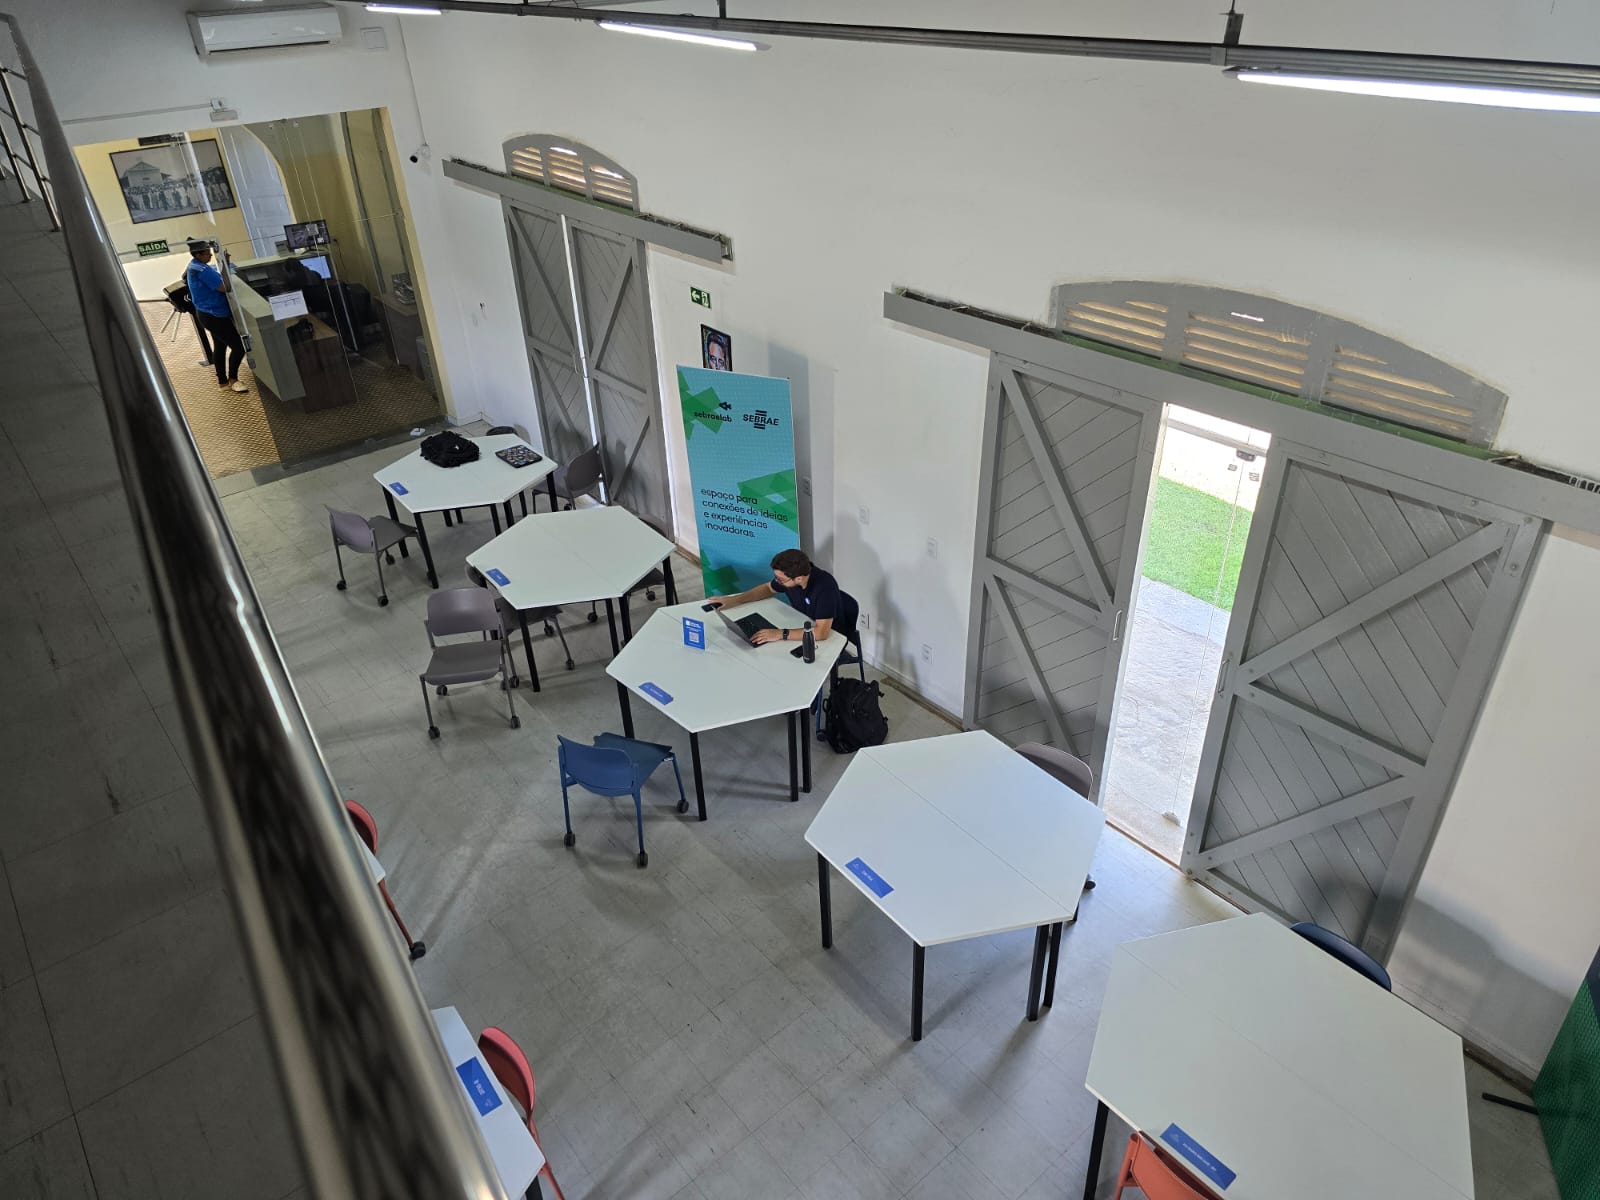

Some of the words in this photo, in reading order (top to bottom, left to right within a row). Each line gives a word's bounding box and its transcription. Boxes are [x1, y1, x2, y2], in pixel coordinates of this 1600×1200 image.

[138, 242, 167, 252] SAÍDA
[694, 411, 732, 423] sebraelab
[742, 413, 780, 426] SEBRAE
[701, 488, 734, 501] espaço
[736, 495, 758, 505] para
[702, 500, 745, 514] conexões
[746, 507, 758, 516] de
[760, 509, 788, 522] ideias
[704, 520, 756, 538] inovadoras.
[711, 512, 768, 529] experiências
